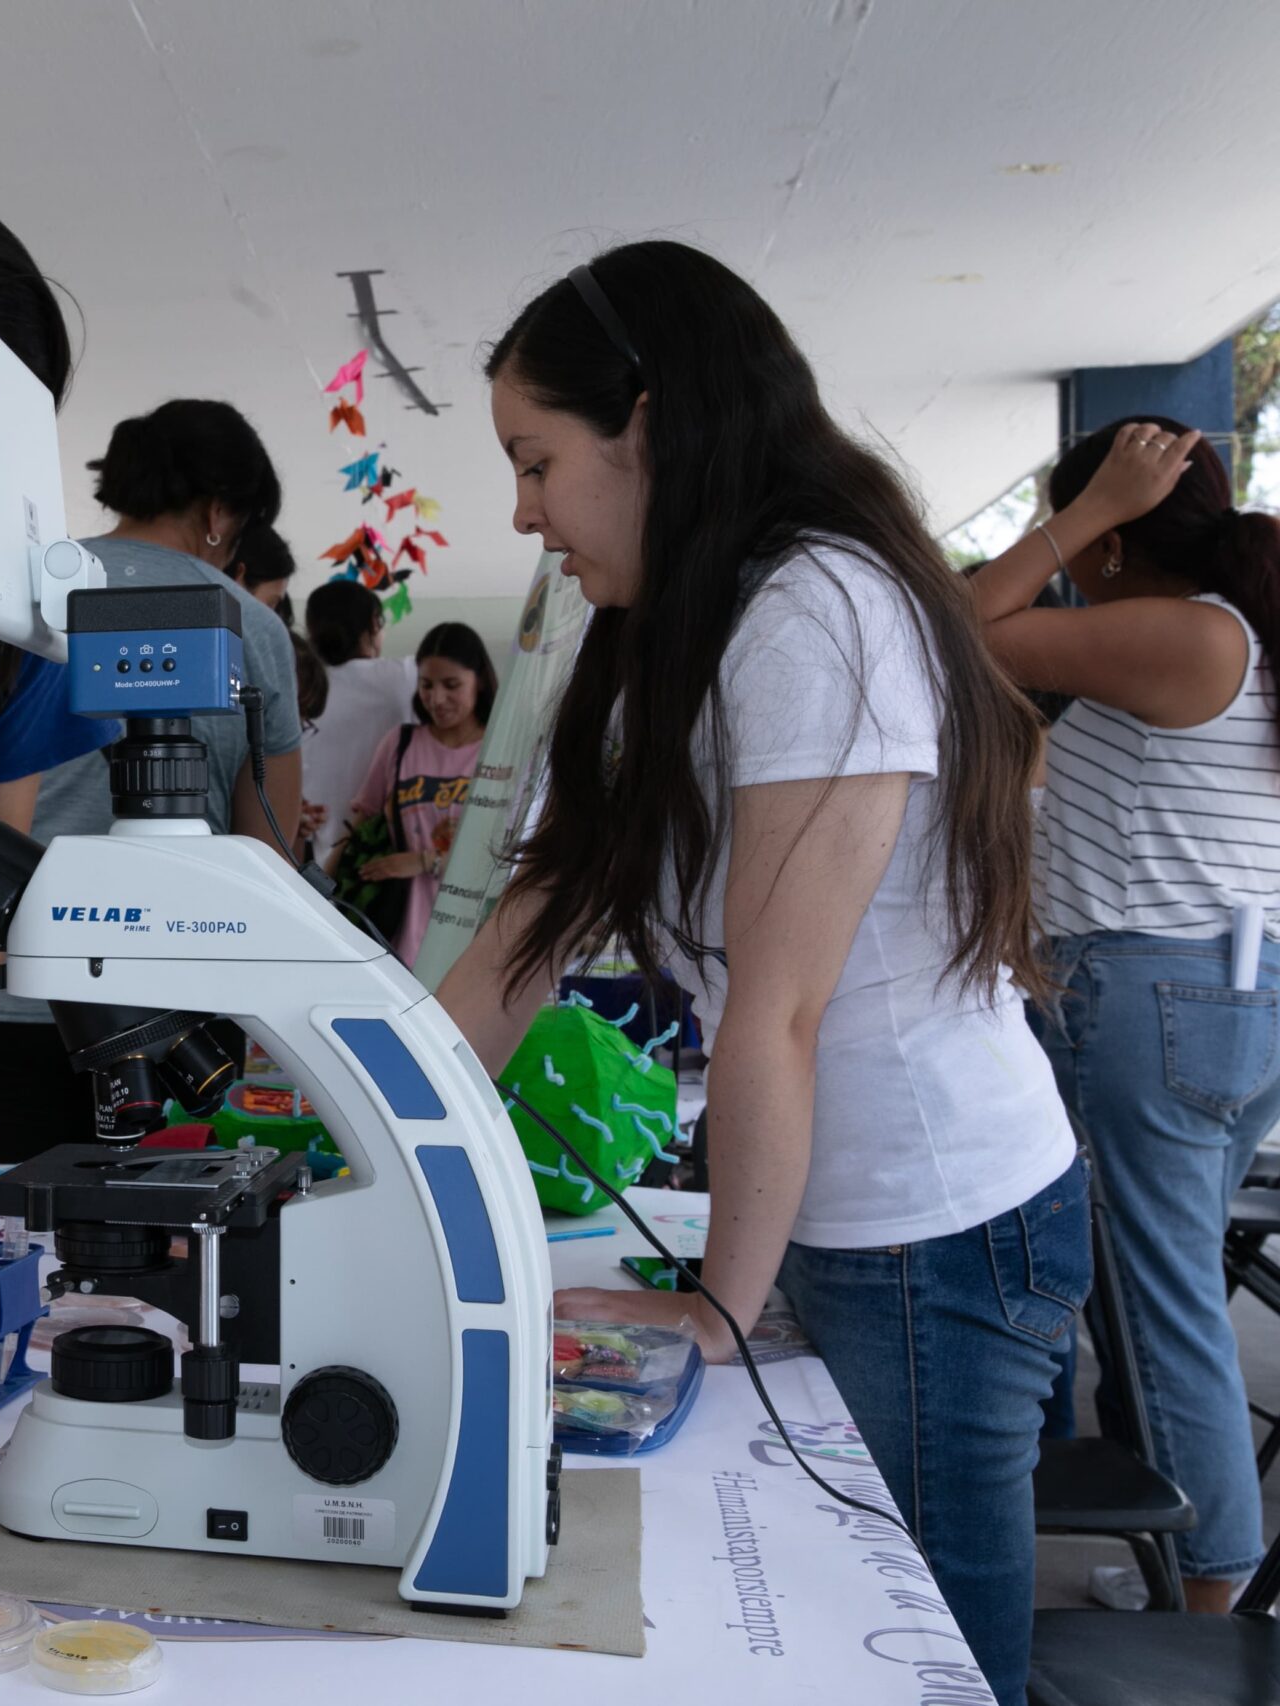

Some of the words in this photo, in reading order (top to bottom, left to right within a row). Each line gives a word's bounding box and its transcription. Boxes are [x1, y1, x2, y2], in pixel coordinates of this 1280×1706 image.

[51, 906, 143, 923] VELAB
[123, 924, 151, 933] PRIME
[166, 920, 247, 934] VE-300PAD
[712, 1470, 786, 1658] #Humanistaporsiempre
